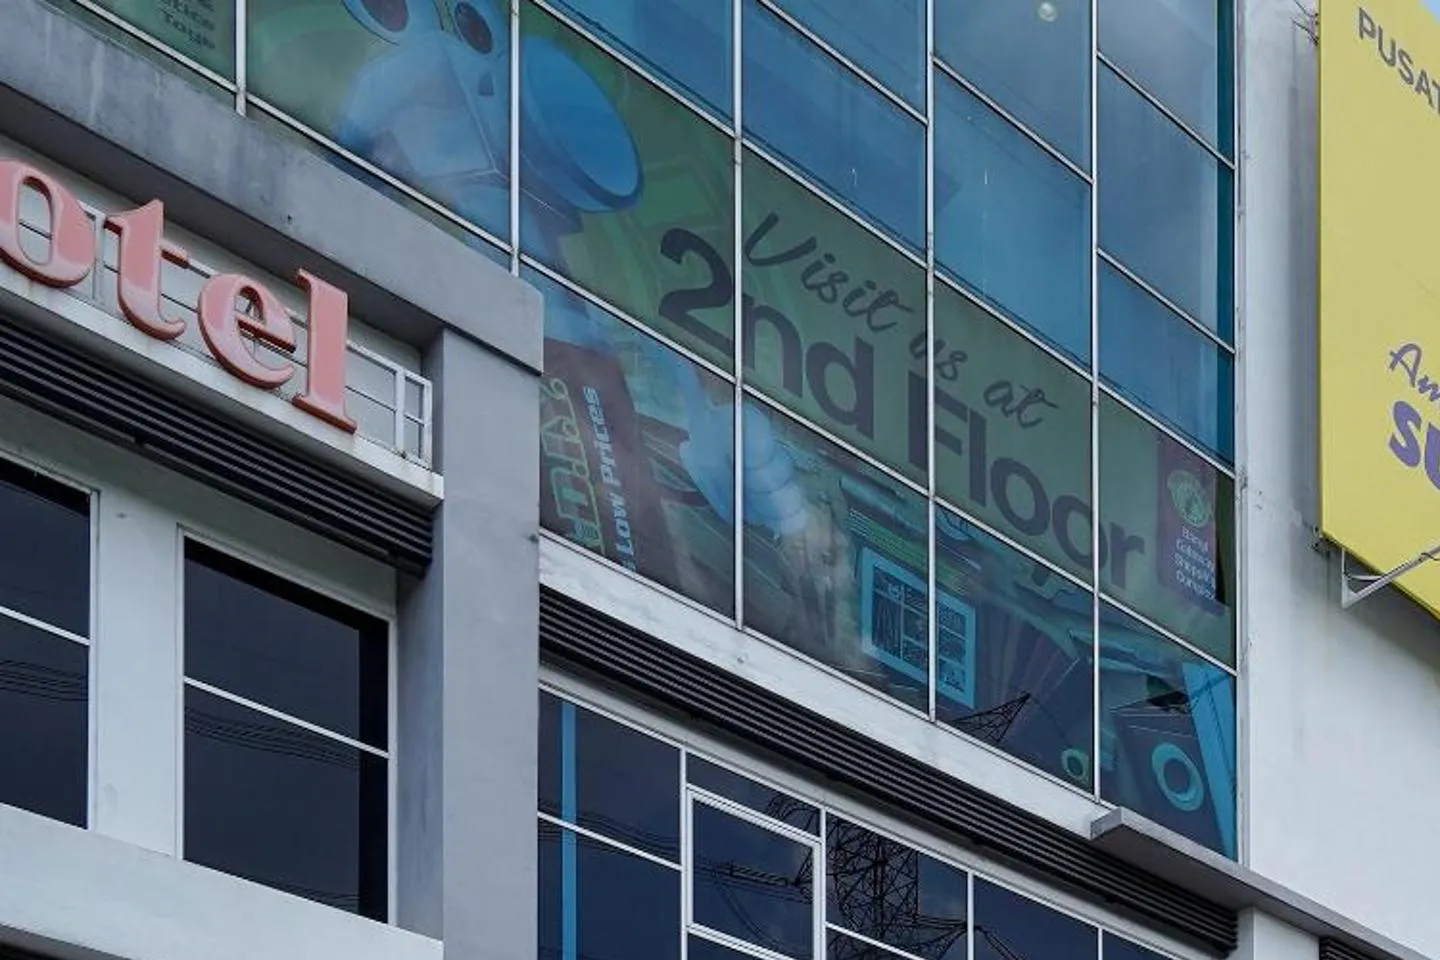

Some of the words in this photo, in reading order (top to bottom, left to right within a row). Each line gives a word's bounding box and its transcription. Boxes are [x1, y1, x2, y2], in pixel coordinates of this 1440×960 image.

[0, 157, 358, 434] otel
[659, 227, 874, 440] 2nd
[907, 369, 1146, 589] Floor
[744, 213, 914, 334] Visit
[909, 325, 975, 384] us
[984, 377, 1058, 430] at
